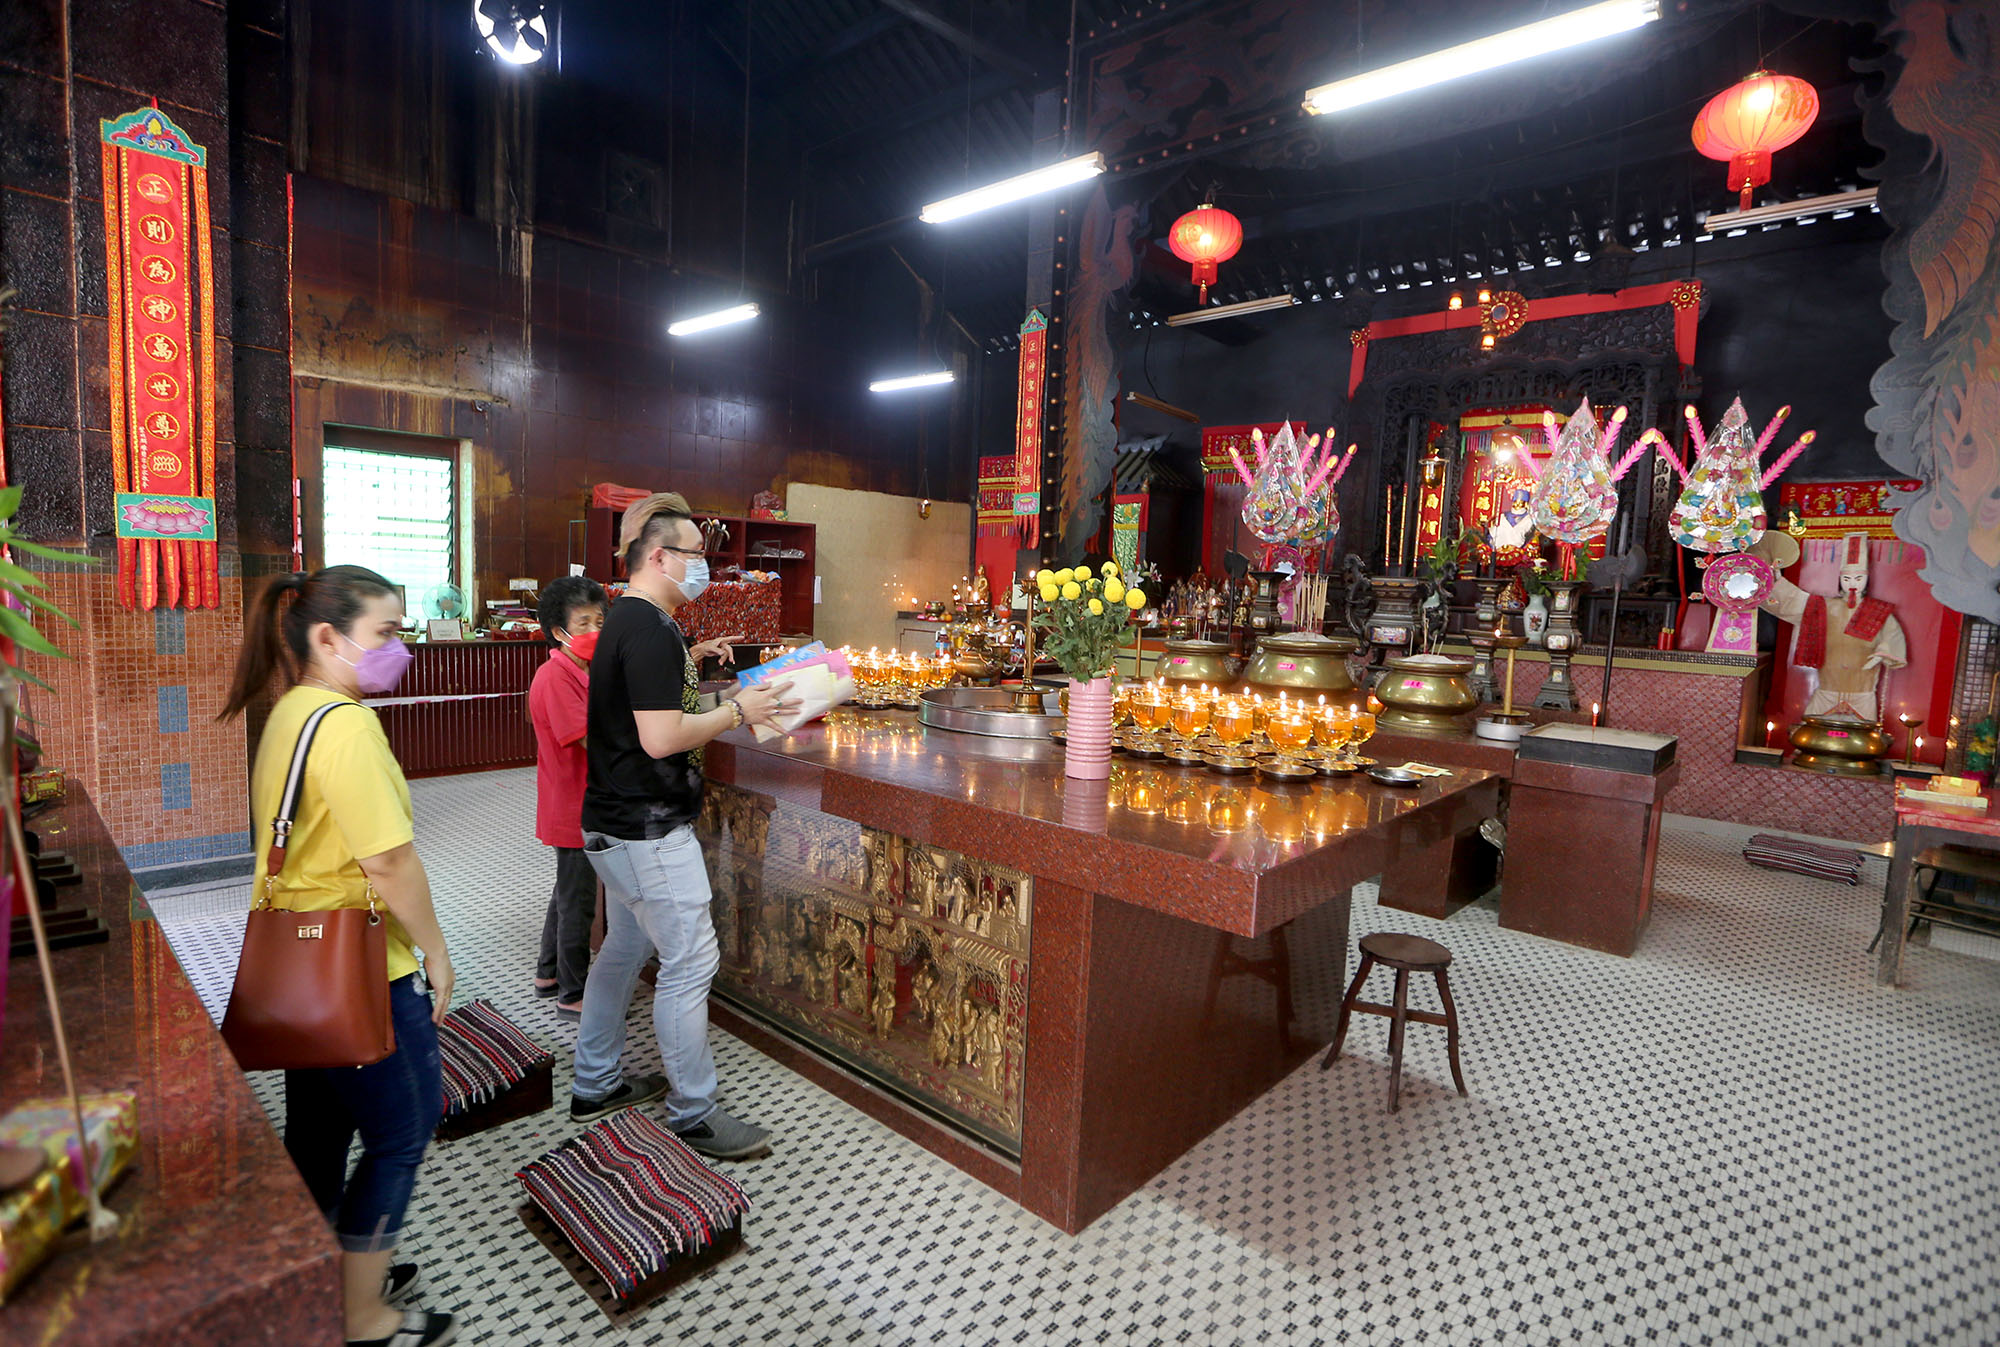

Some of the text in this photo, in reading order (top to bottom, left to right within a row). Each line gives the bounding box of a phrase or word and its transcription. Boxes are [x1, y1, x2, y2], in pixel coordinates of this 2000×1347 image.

[146, 180, 176, 438] 正則為神萬世尊
